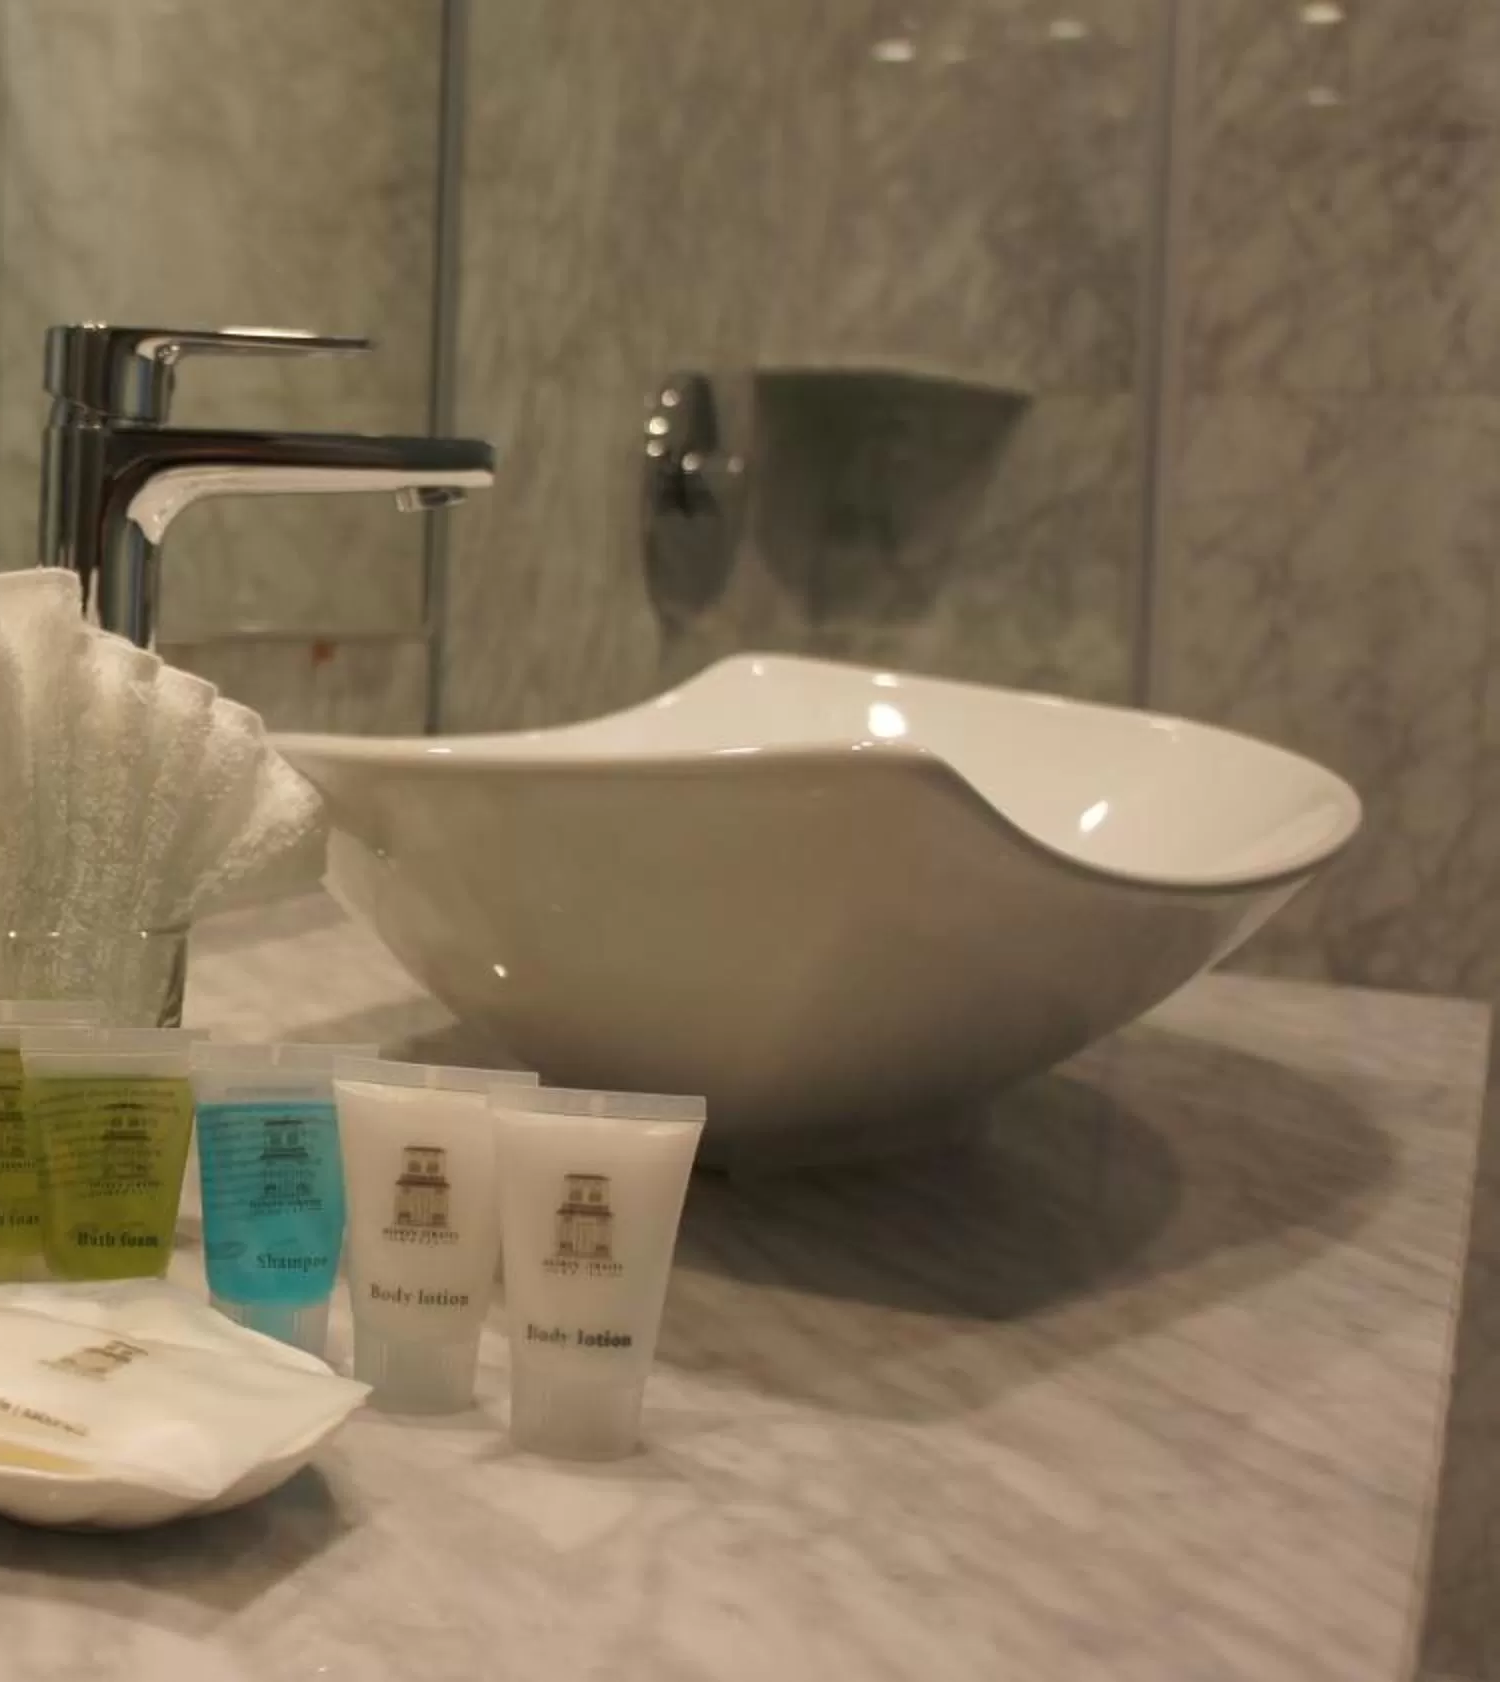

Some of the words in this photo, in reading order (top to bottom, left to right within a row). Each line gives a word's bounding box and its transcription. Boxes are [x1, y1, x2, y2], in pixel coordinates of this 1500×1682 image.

[119, 1230, 159, 1248] foam
[369, 1282, 413, 1306] Body
[418, 1288, 469, 1306] lotion
[526, 1323, 570, 1349] Body
[577, 1327, 632, 1348] lotion
